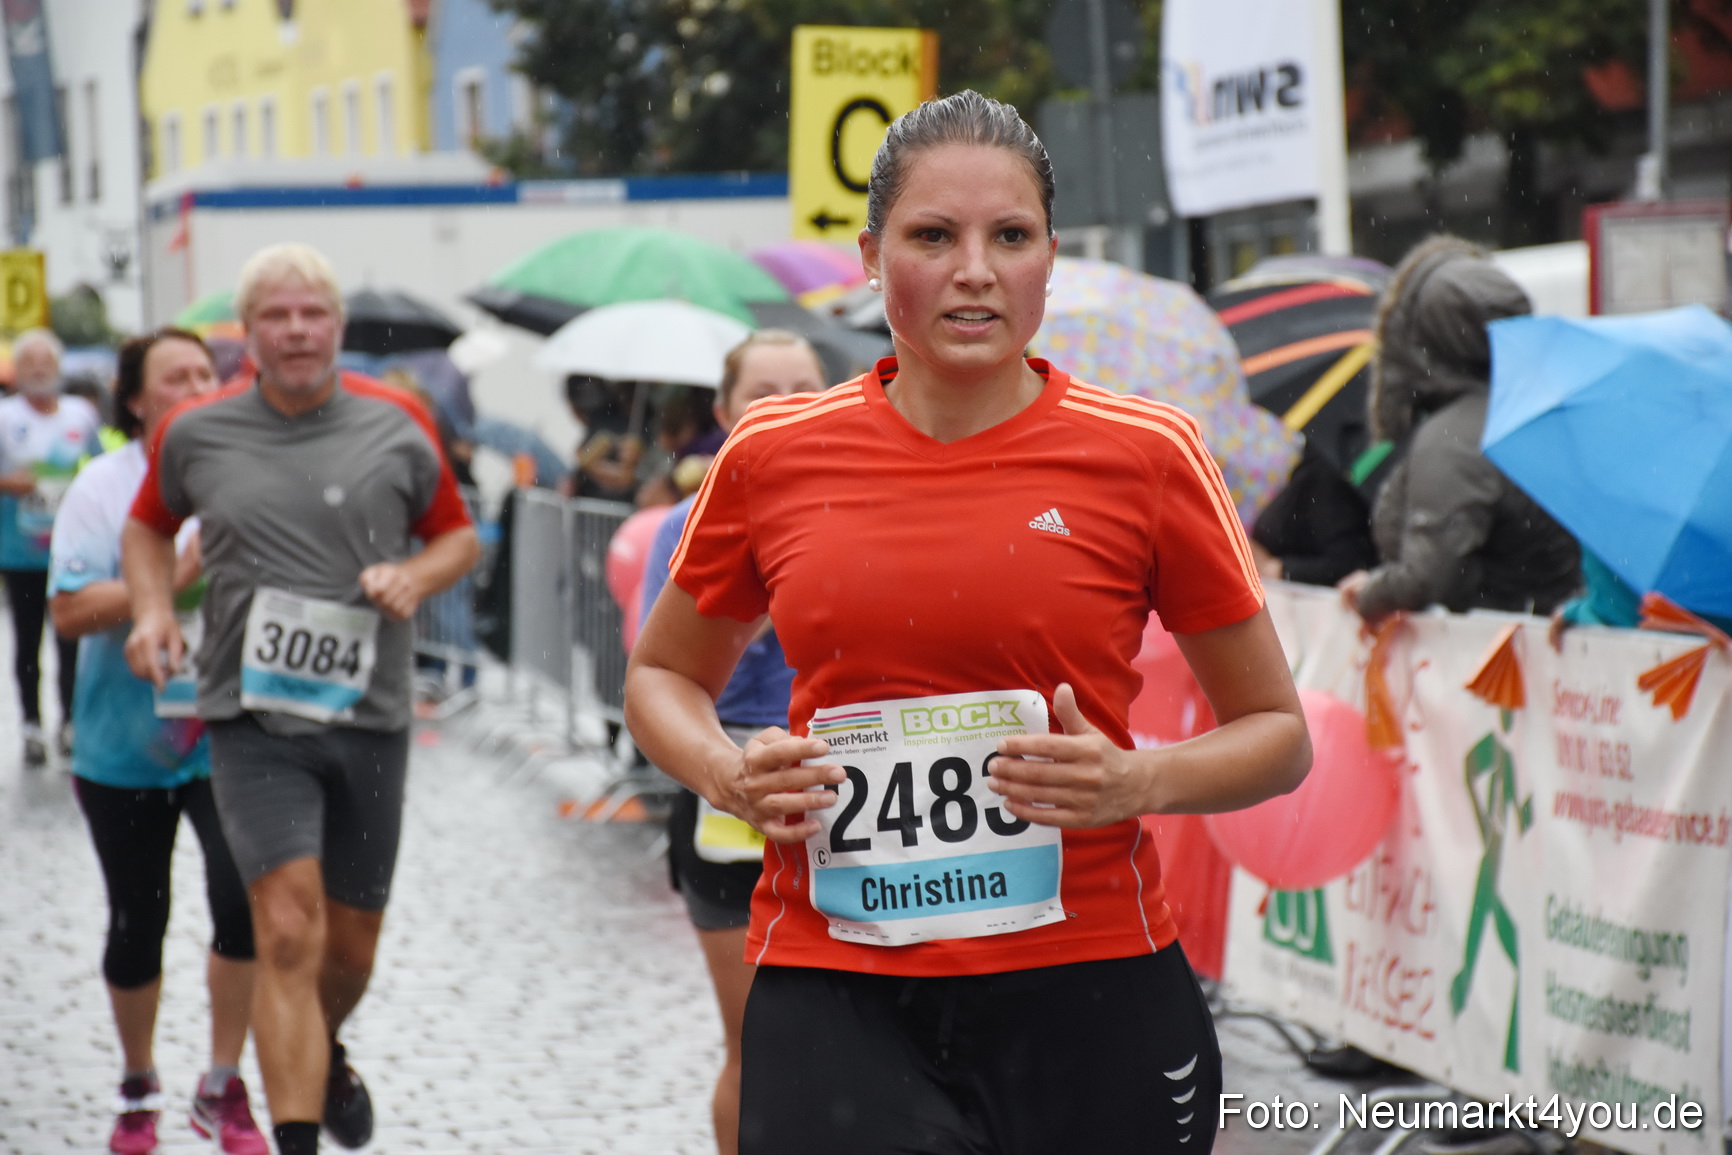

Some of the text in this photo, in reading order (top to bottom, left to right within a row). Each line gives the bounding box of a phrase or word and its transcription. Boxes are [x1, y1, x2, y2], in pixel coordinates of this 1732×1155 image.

[811, 37, 919, 77] Block
[831, 97, 891, 193] C
[1028, 520, 1071, 536] adidas
[256, 621, 362, 678] 3084
[900, 701, 1024, 736] BOCK
[903, 728, 1028, 747] inspired by smart concepts
[818, 850, 826, 865] C
[861, 869, 1008, 912] Christina
